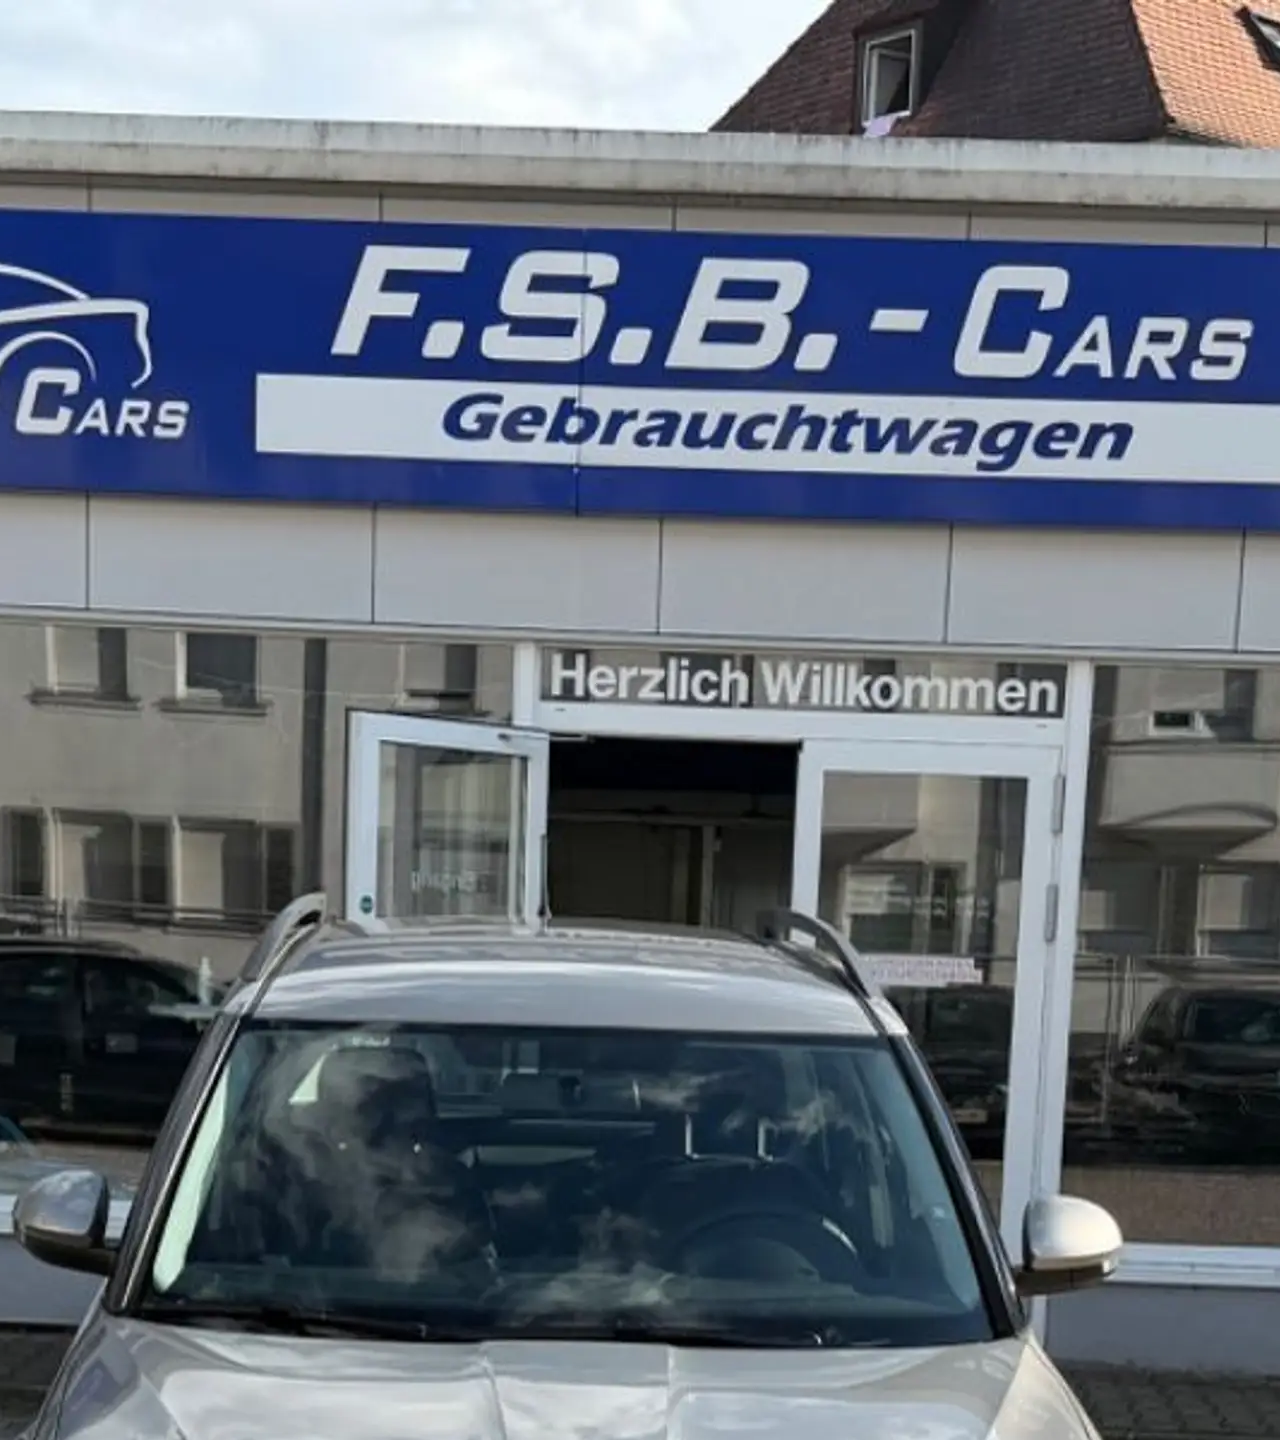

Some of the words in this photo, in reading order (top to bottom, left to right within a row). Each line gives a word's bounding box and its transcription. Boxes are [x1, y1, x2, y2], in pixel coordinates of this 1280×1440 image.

[442, 392, 1134, 467] Gebrauchtwagen
[550, 653, 750, 704] Herzlich
[760, 660, 1058, 713] Willkommen
